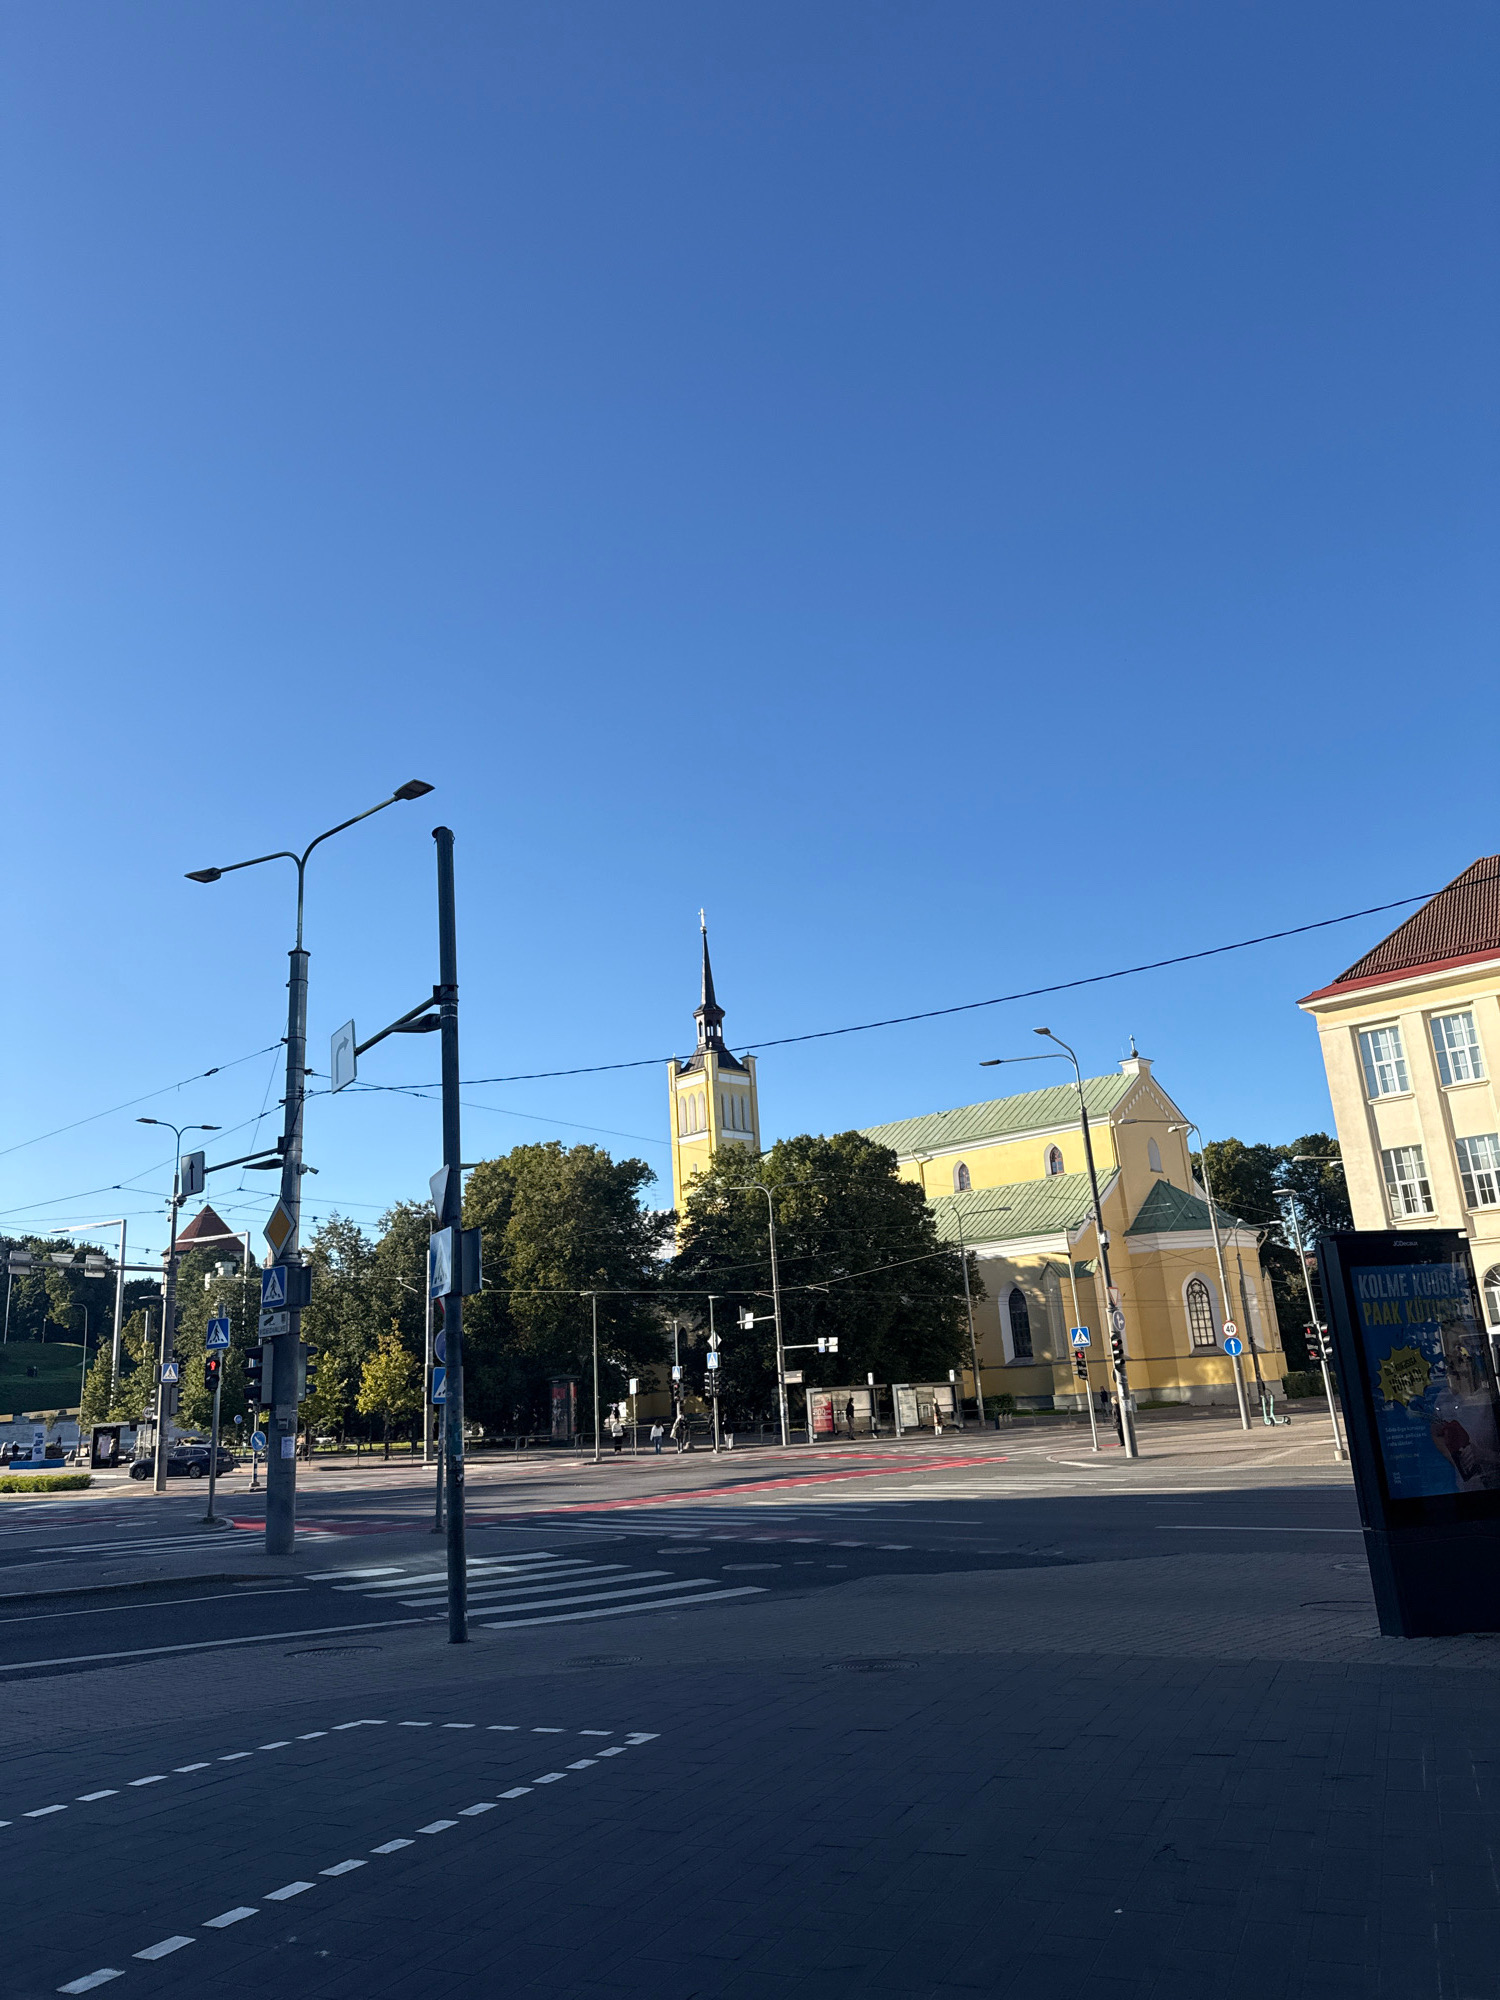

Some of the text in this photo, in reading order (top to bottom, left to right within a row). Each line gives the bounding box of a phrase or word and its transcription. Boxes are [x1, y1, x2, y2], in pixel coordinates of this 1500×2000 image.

[1358, 1274, 1409, 1299] KOLME
[1362, 1301, 1402, 1326] PAAK
[1225, 1325, 1235, 1333] 40
